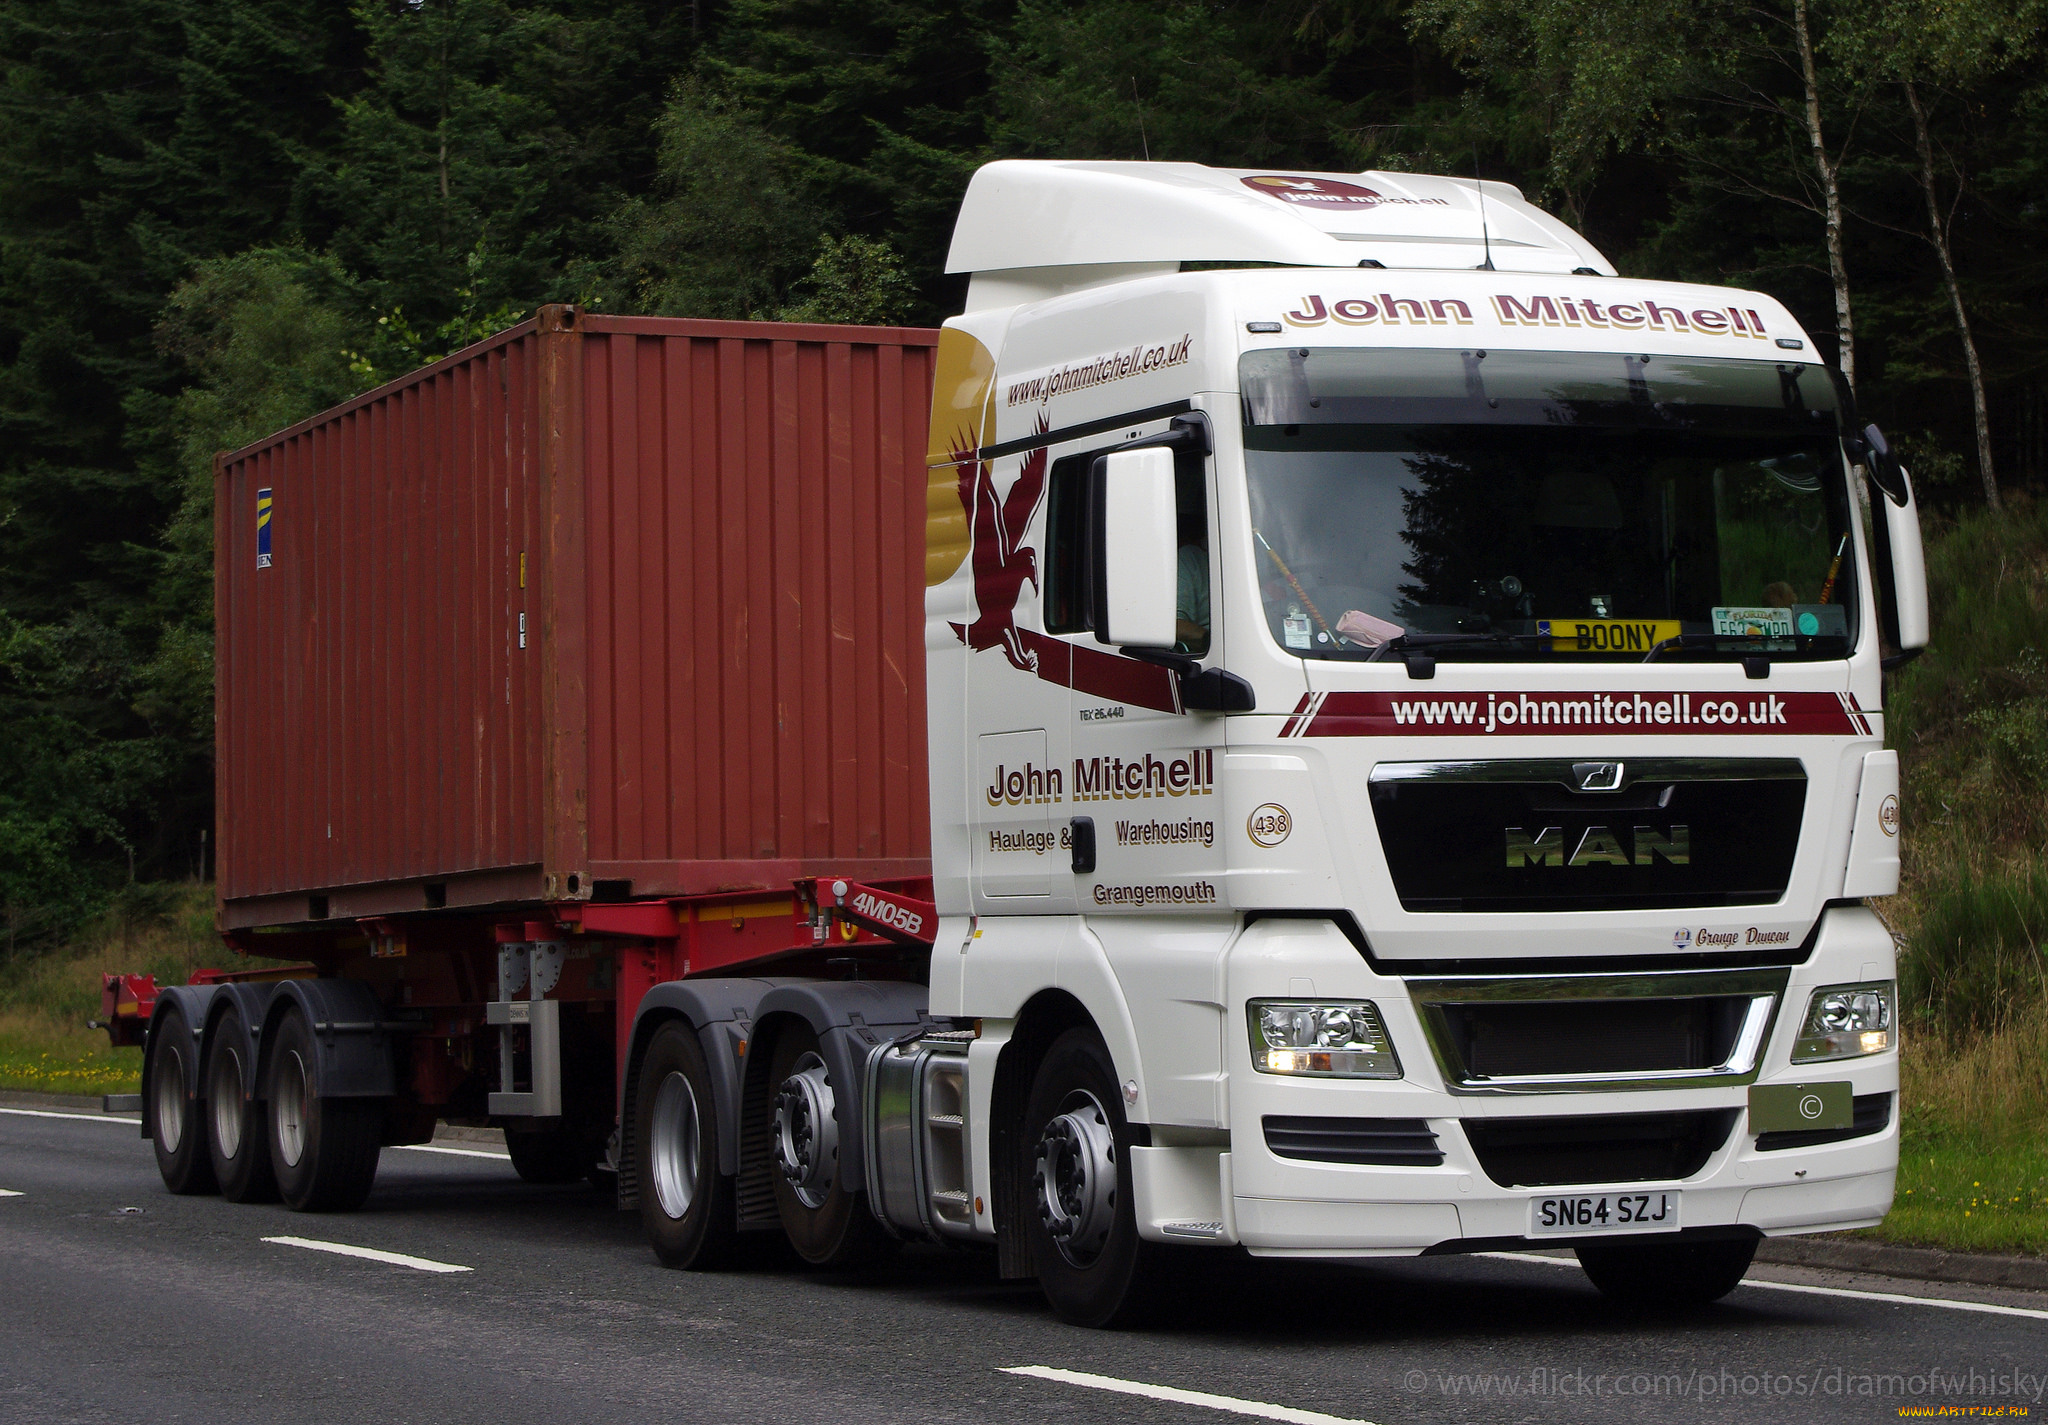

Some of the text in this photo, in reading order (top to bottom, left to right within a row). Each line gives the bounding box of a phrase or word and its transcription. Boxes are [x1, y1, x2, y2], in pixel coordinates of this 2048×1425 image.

[1283, 293, 1769, 340] John Mitchell
[1008, 333, 1193, 407] www.johnmitchell.co.uk
[1575, 624, 1656, 650] BOONY
[1391, 693, 1787, 733] www.johnmitchell.co.uk
[987, 748, 1213, 807] John Mitchell
[989, 817, 1214, 855] Haulage & Warehousing
[1253, 815, 1287, 836] 438
[1505, 824, 1690, 868] MAN
[852, 892, 923, 934] 4M05B
[1093, 880, 1216, 907] Grangemouth
[1696, 927, 1790, 949] Grange Duncan
[1541, 1194, 1667, 1226] SN64 SZJ
